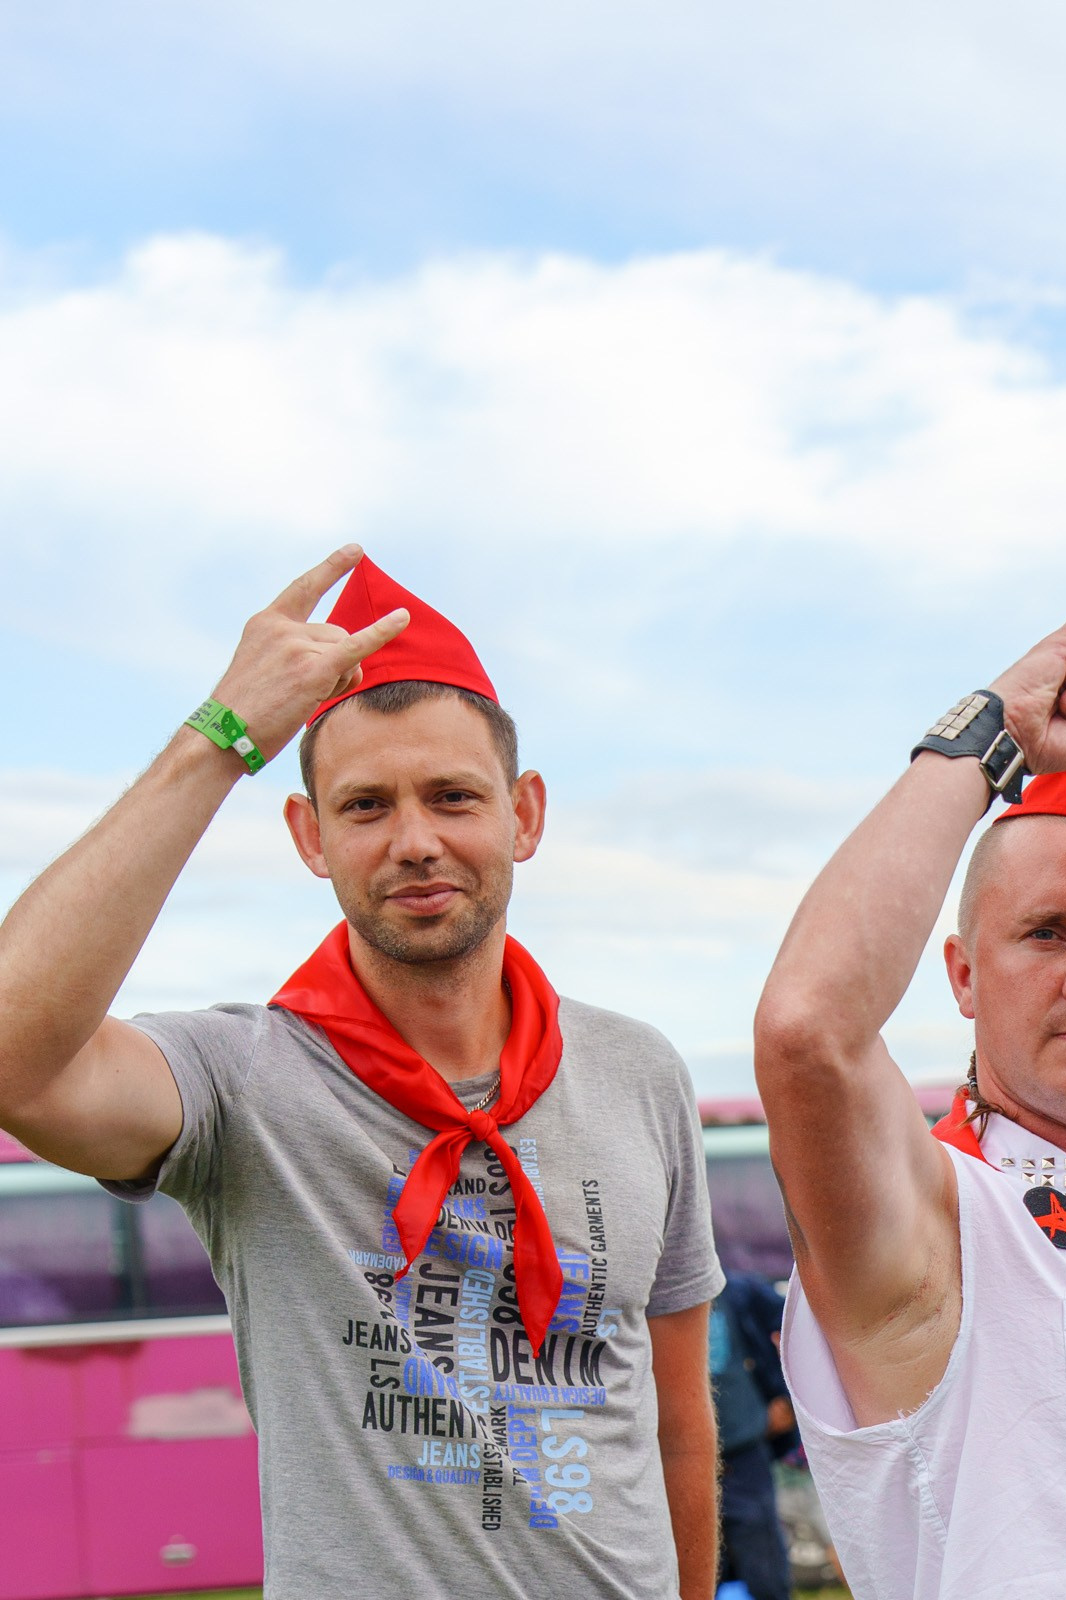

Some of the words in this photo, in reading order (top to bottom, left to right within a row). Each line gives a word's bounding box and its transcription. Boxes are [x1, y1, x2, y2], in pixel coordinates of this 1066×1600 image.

[582, 1179, 607, 1252] GARMENTS
[423, 1229, 503, 1270] ESIGN
[413, 1263, 460, 1374] JEANS
[548, 1247, 590, 1334] JEANS
[581, 1258, 608, 1338] AUTHENTIC
[342, 1319, 412, 1355] JEANS
[458, 1268, 497, 1415] ESTABLISHED
[490, 1327, 607, 1387] DENIM
[369, 1358, 401, 1390] LS
[417, 1440, 481, 1469] JEANS
[508, 1402, 540, 1462] DEPT
[435, 1469, 481, 1484] QUALITY
[481, 1442, 503, 1532] ESTABLISHED
